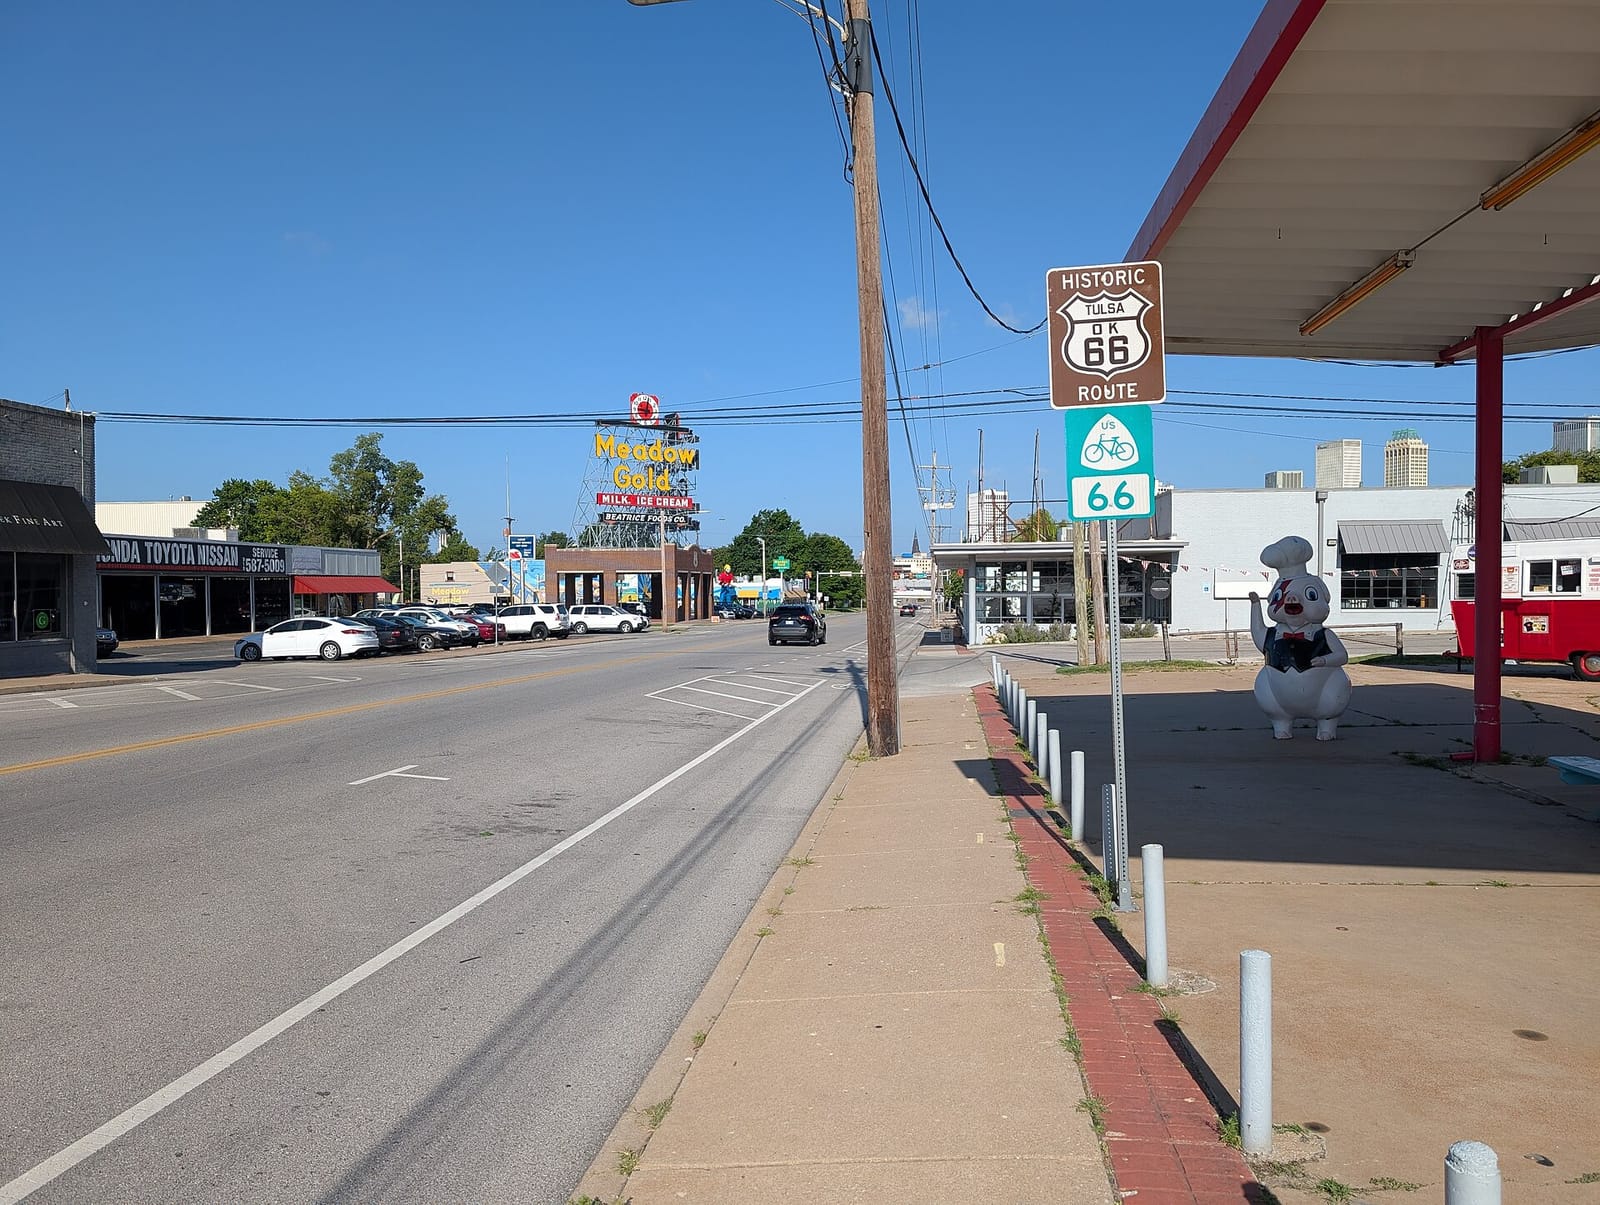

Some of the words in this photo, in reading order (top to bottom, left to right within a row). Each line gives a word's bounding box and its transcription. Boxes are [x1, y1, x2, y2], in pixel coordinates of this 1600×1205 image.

[1062, 268, 1145, 290] HISTORIC
[1085, 302, 1125, 316] TULSA
[1084, 335, 1129, 366] 66
[1078, 383, 1138, 401] ROUTE
[1101, 421, 1116, 430] US
[595, 433, 695, 464] Meadow
[614, 465, 670, 491] Gold
[637, 496, 653, 505] ICE
[656, 497, 689, 507] CREAM
[1088, 481, 1135, 511] 66
[42, 517, 64, 527] ART
[605, 513, 646, 521] BEATRICE
[144, 541, 195, 565] TOYOTA
[199, 544, 239, 567] NISSAN
[252, 547, 279, 558] SERVICE
[245, 558, 285, 573] 587-5009
